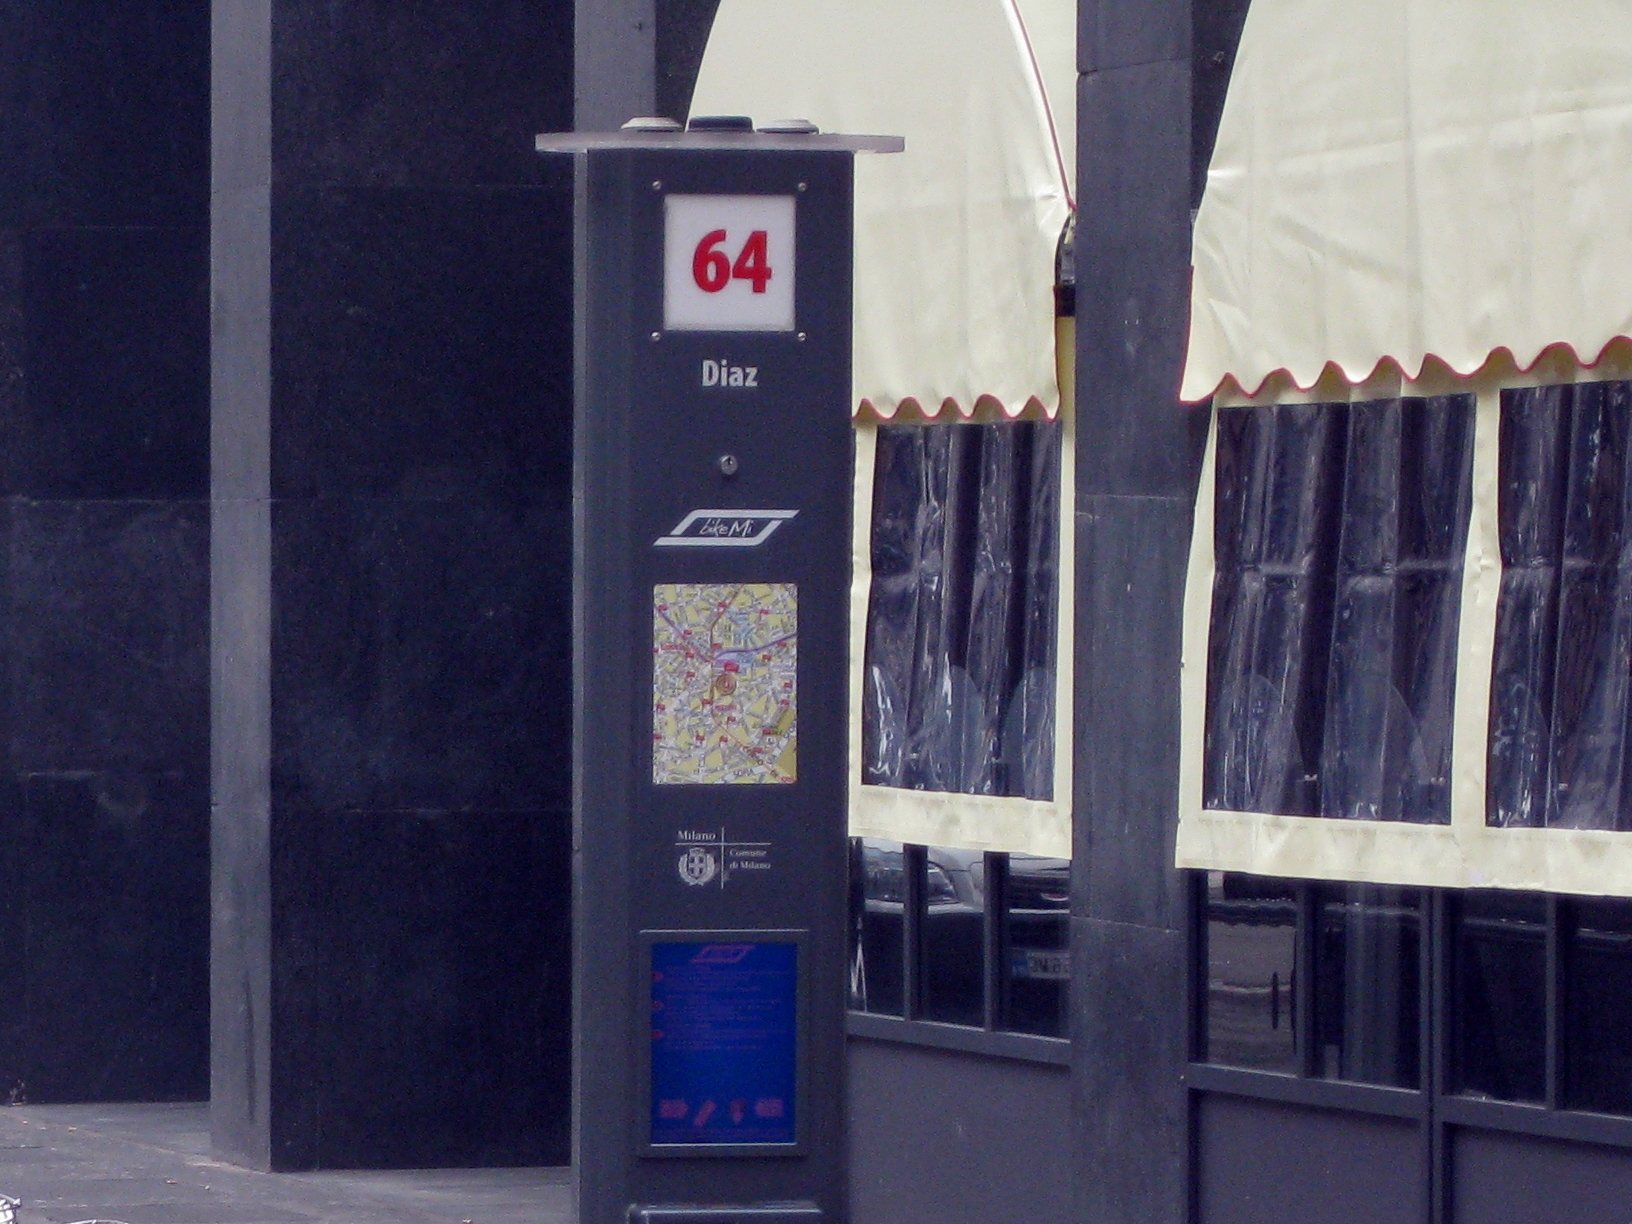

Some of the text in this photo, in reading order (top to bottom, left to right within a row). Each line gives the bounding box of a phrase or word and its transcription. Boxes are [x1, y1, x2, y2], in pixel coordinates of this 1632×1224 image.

[692, 229, 772, 293] 64
[702, 359, 758, 387] Diaz
[699, 518, 754, 537] bikeMi
[677, 829, 716, 841] Milano
